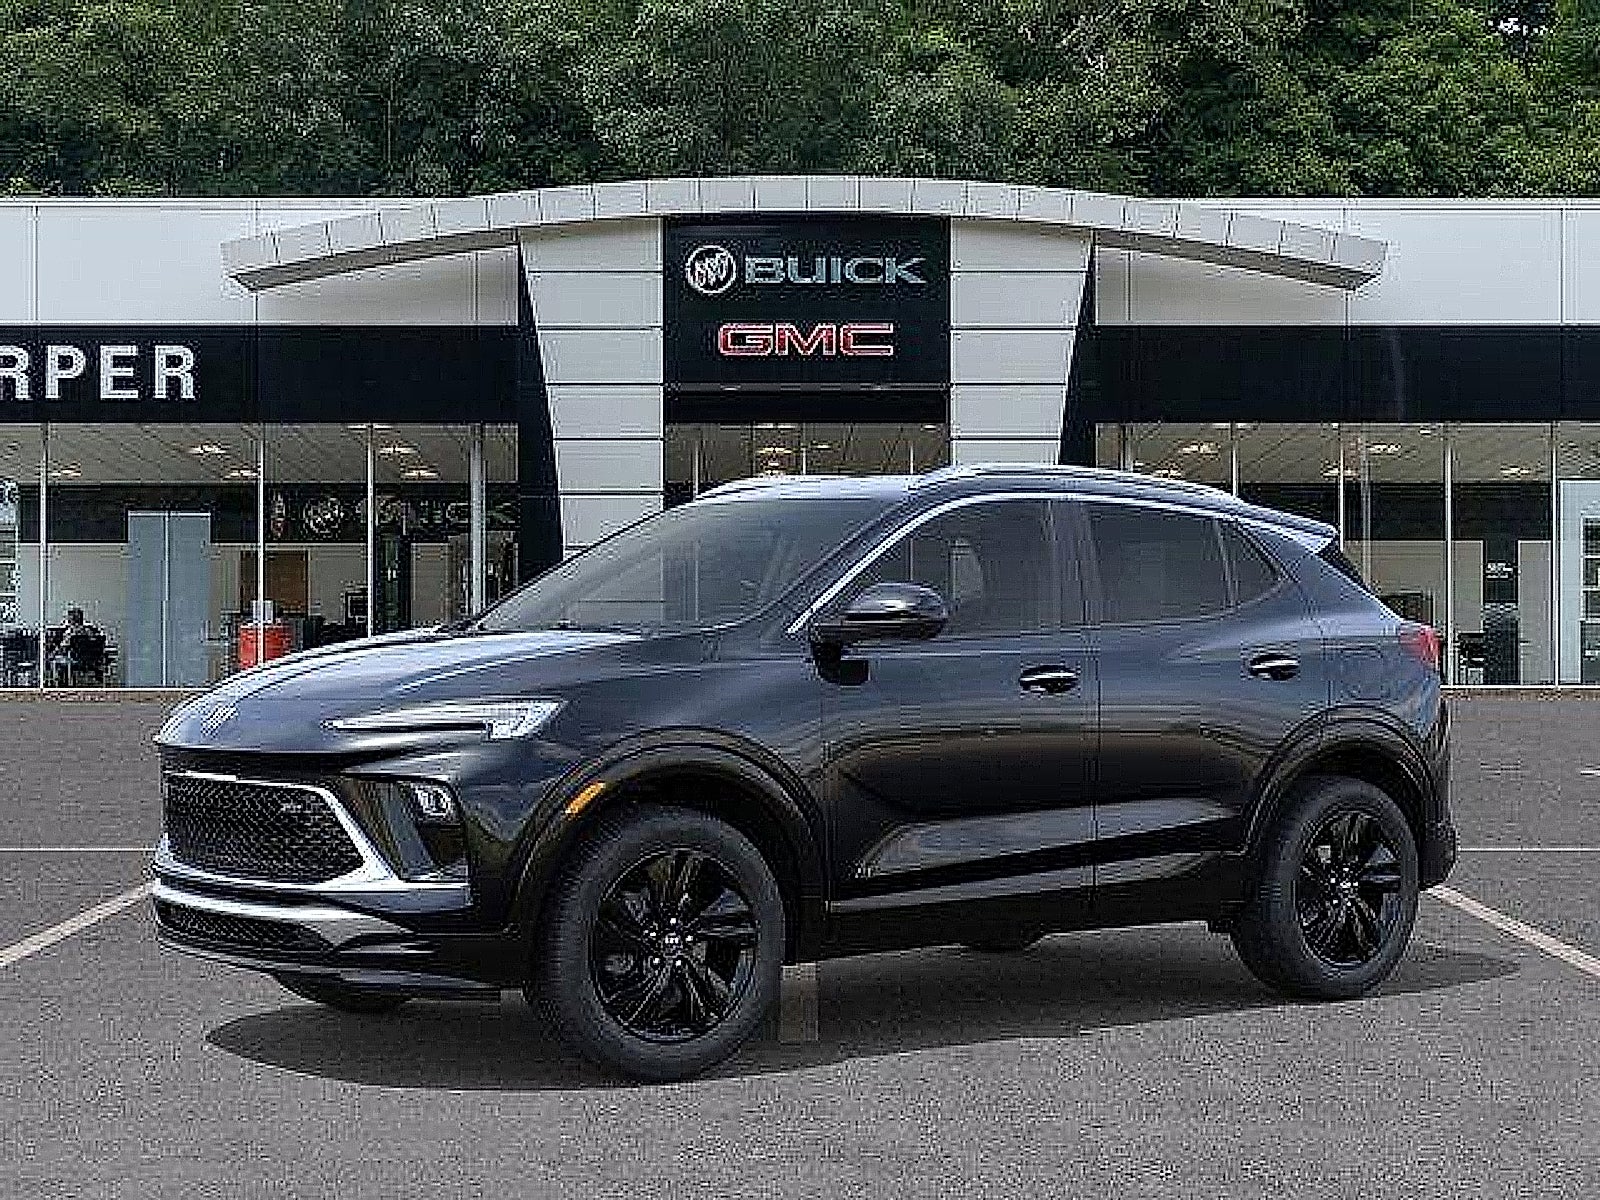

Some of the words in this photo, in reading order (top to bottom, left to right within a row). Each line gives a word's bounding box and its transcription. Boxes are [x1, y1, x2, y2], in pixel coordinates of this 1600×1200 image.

[745, 257, 927, 284] BUICK
[719, 322, 894, 356] GMC
[0, 345, 195, 399] RPER
